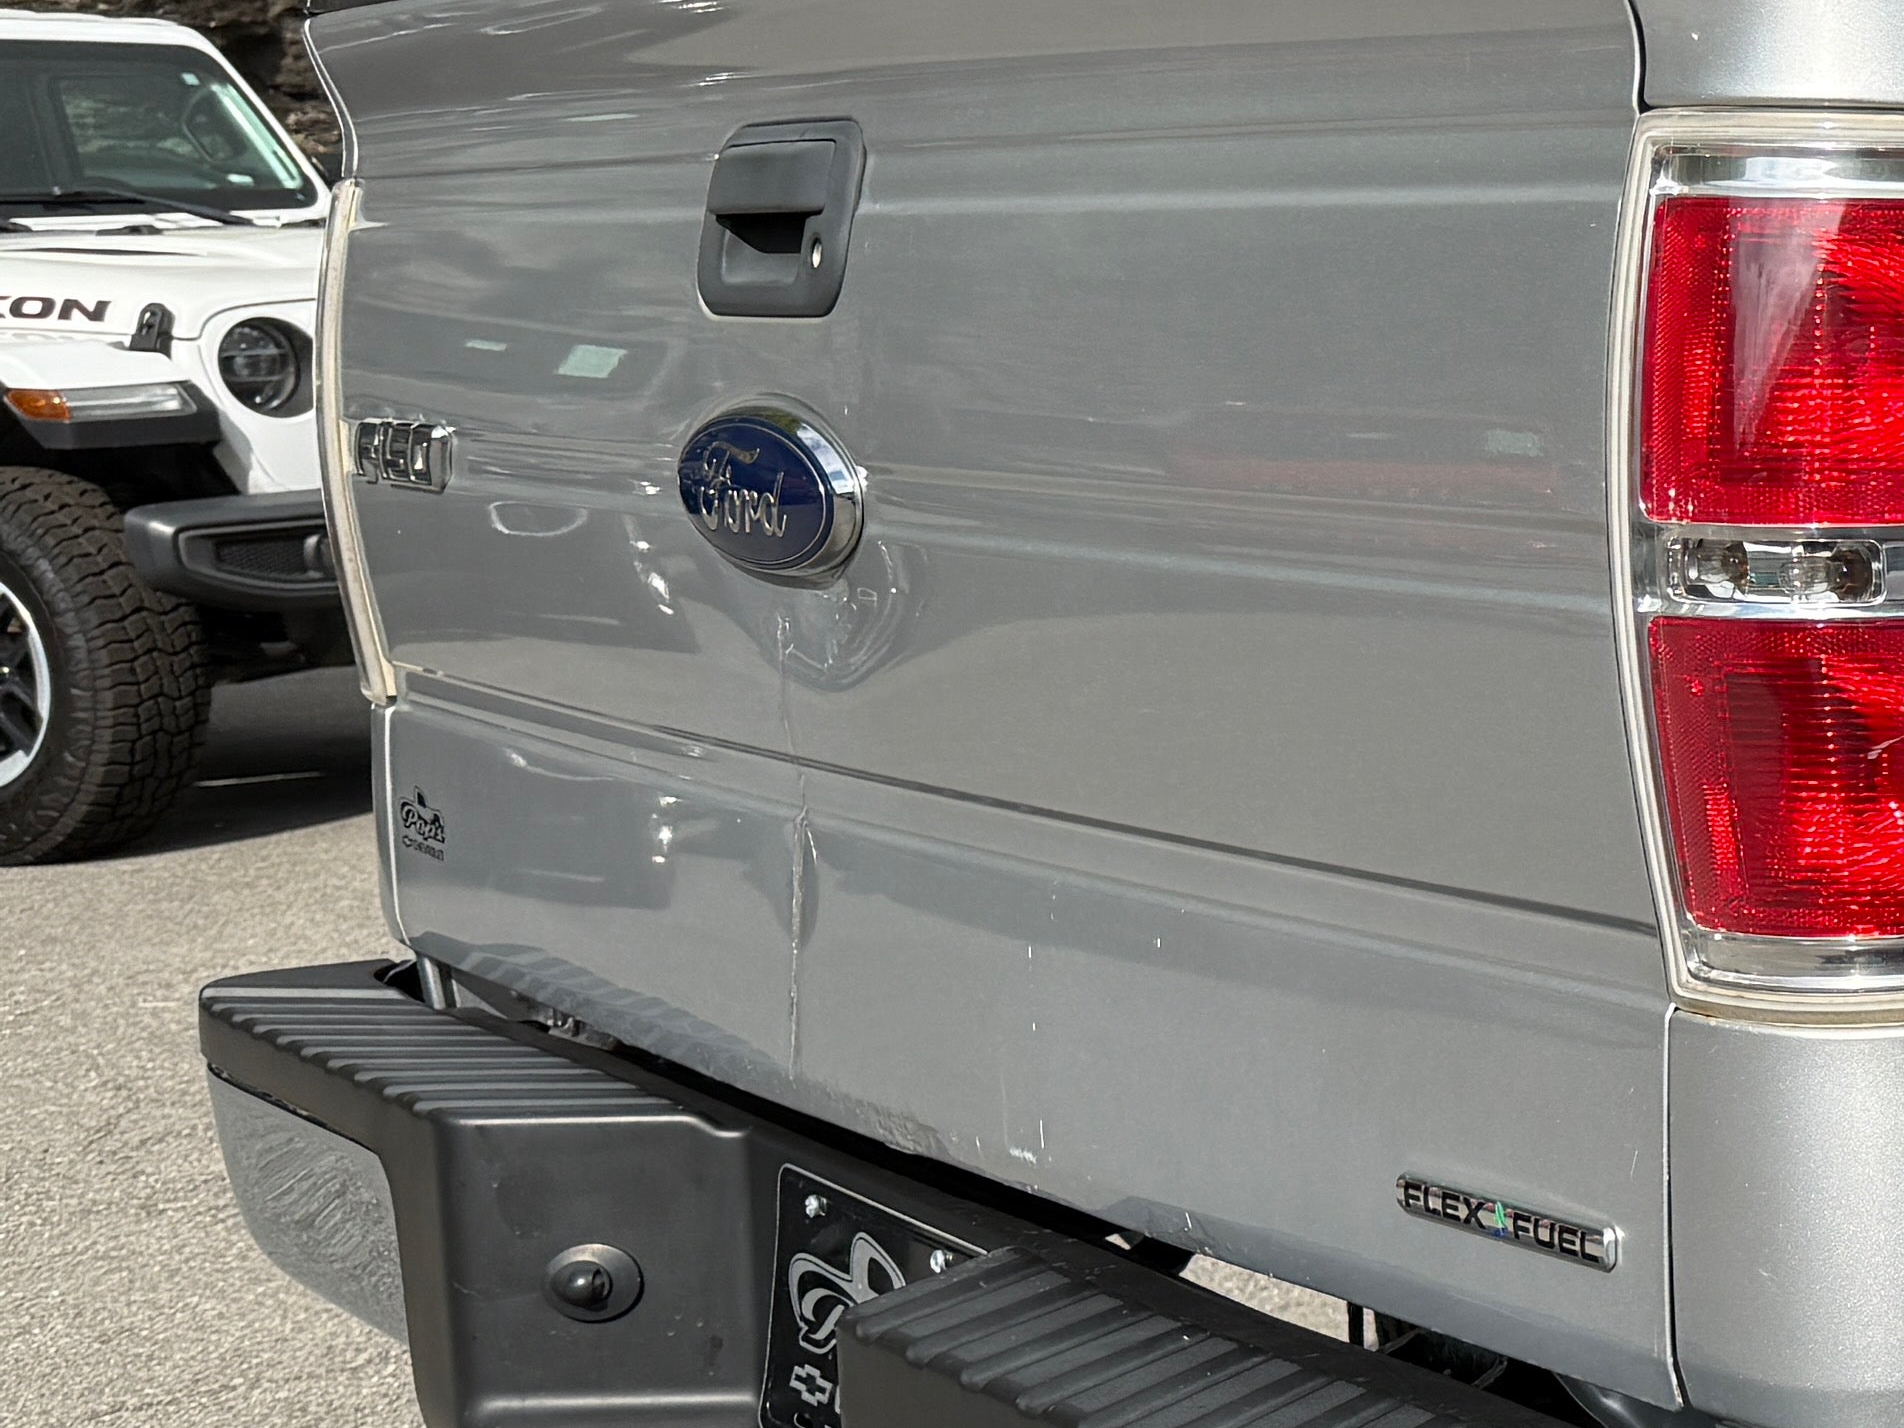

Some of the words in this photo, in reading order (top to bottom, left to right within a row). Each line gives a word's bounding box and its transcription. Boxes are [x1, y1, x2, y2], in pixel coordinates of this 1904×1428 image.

[0, 296, 112, 322] ON
[701, 440, 788, 539] Ford
[1403, 1179, 1487, 1230] FLEX
[1511, 1210, 1600, 1264] FUEL
